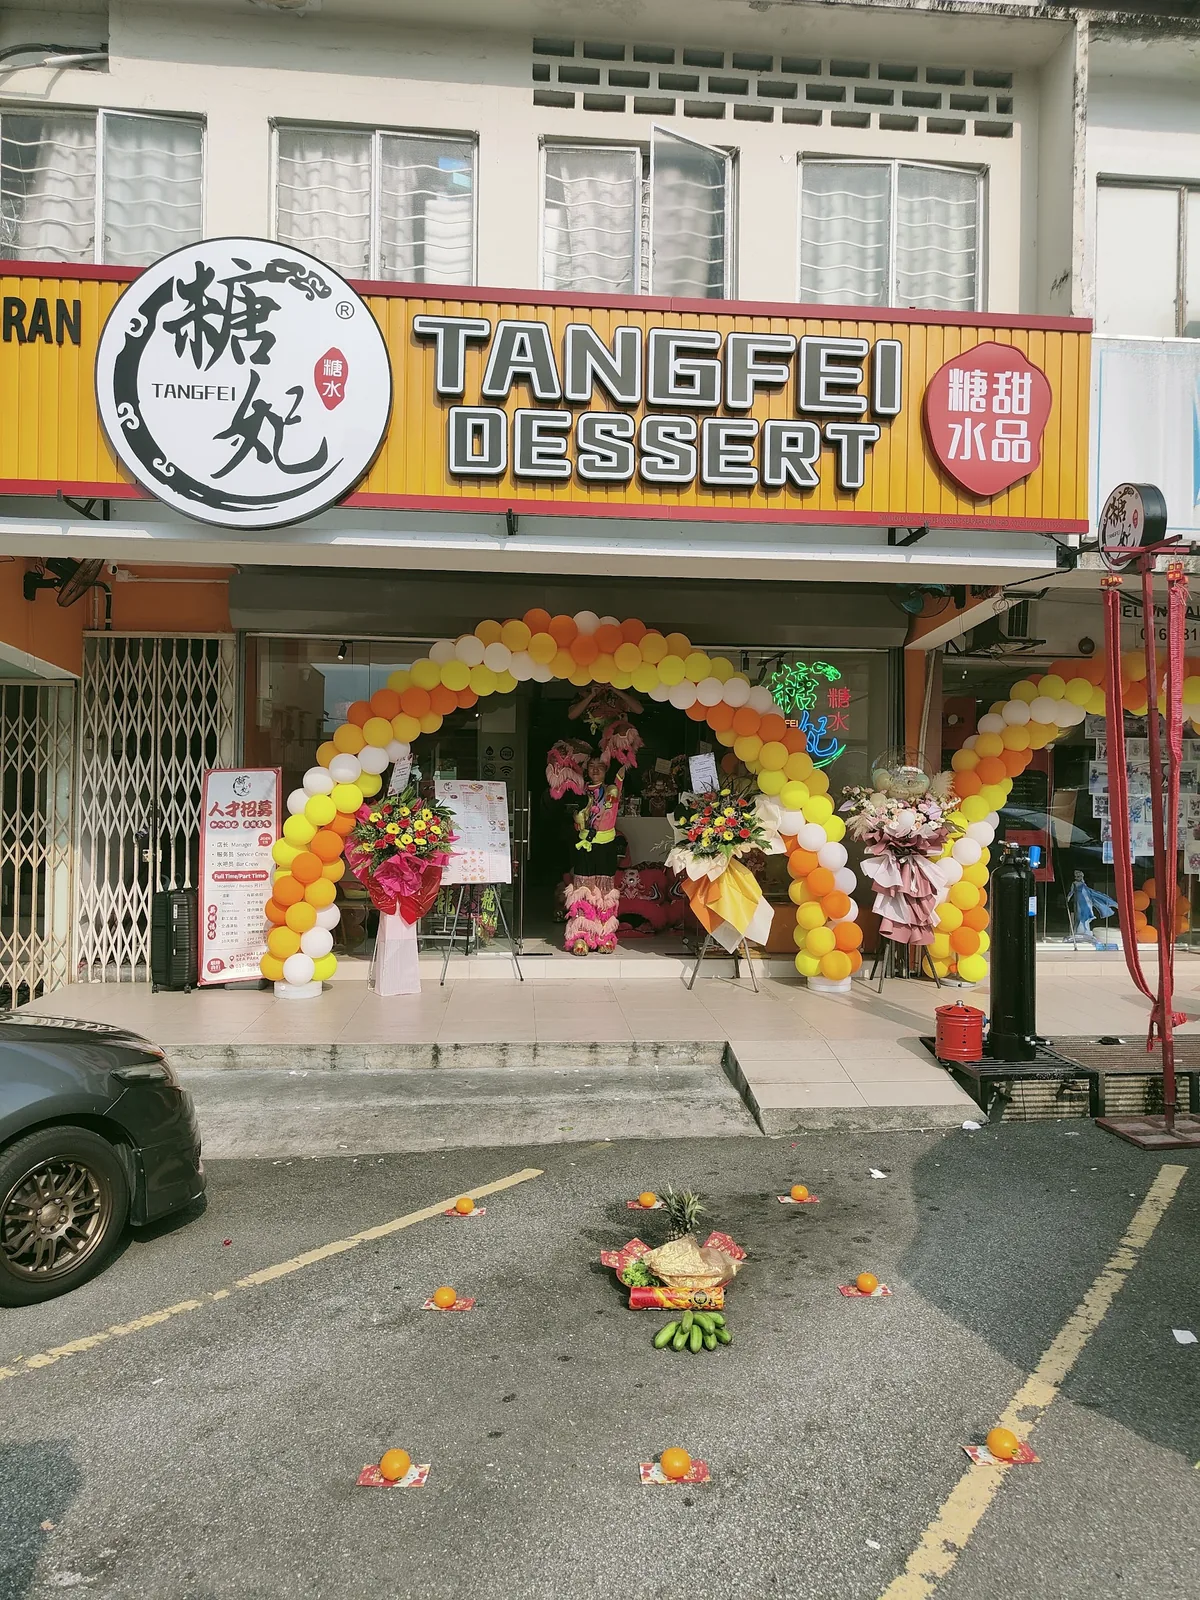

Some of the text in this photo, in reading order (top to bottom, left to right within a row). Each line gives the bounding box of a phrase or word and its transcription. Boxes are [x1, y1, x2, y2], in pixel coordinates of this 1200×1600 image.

[3, 297, 81, 345] RAN
[323, 358, 343, 398] 糖水
[413, 314, 903, 417] TANGFEI
[151, 383, 237, 402] TANGFEI
[948, 368, 988, 461] 糖水
[992, 370, 1032, 463] 甜品
[448, 405, 882, 491] DESSERT
[827, 686, 851, 731] 糖水
[208, 800, 273, 818] 人才招募
